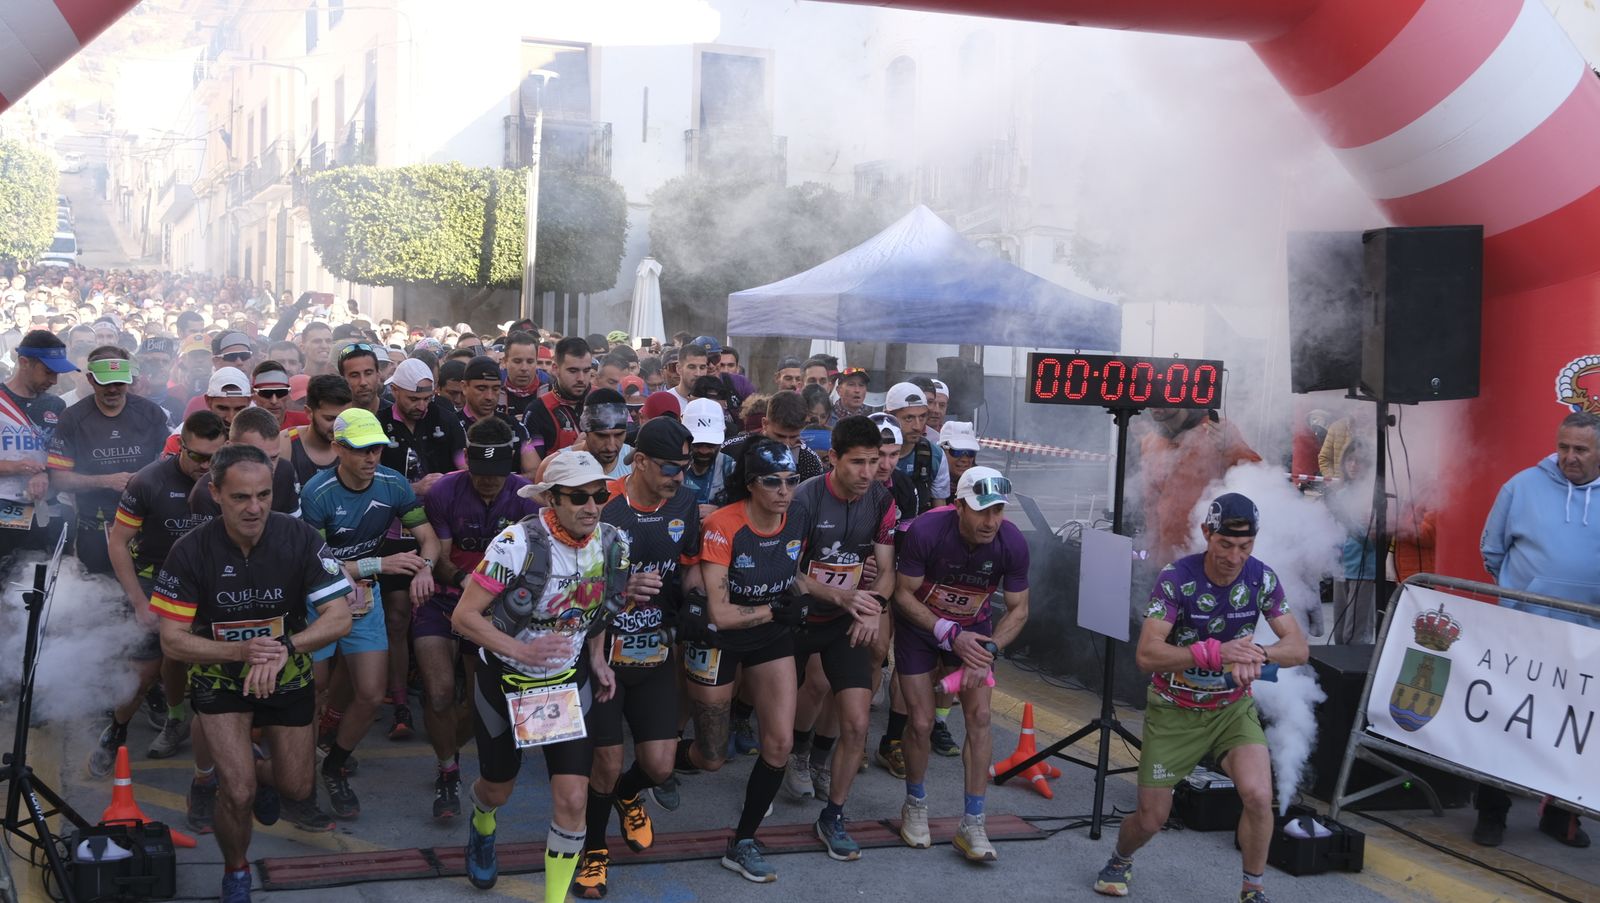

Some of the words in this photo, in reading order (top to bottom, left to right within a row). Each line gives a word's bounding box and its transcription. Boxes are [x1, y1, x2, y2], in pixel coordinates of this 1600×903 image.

[825, 571, 848, 586] 77
[945, 593, 970, 606] 38
[1477, 648, 1594, 695] AYUNT
[532, 703, 561, 720] 43
[1464, 679, 1594, 755] CAN
